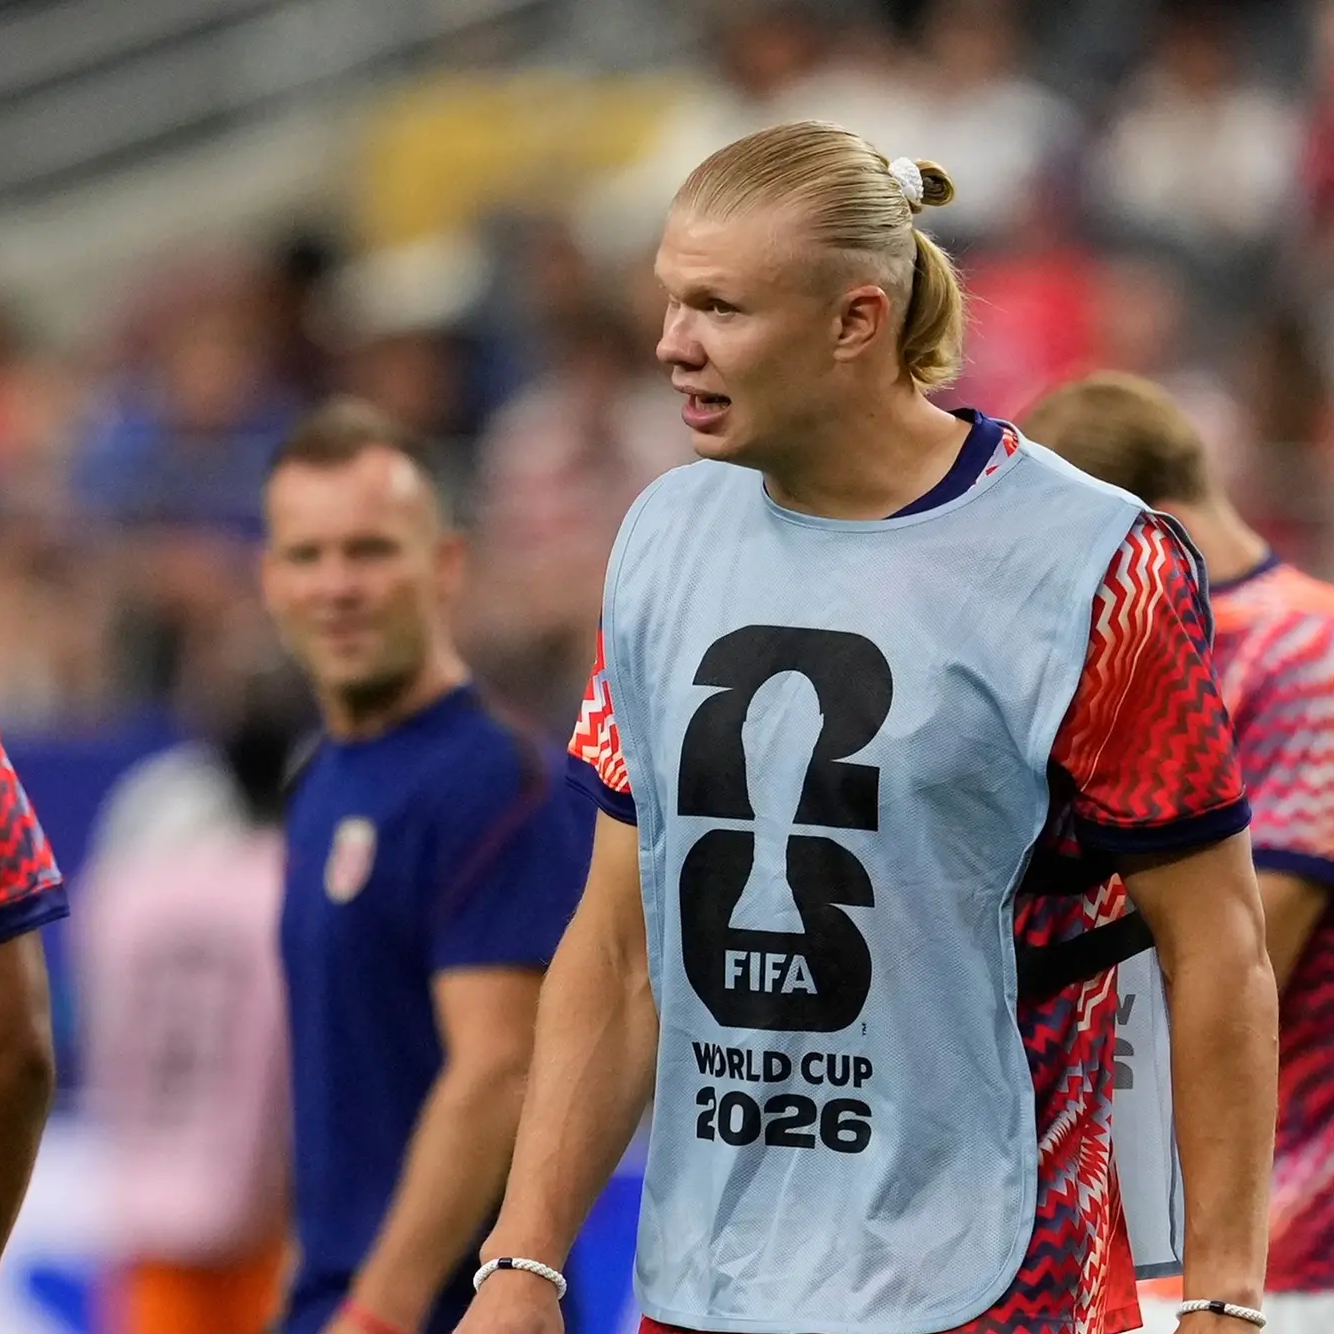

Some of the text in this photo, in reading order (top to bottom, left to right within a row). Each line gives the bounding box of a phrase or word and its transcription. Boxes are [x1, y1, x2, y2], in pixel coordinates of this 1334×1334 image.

[725, 950, 818, 994] FIFA
[801, 1052, 873, 1088] CUP
[696, 1086, 872, 1153] 2026
